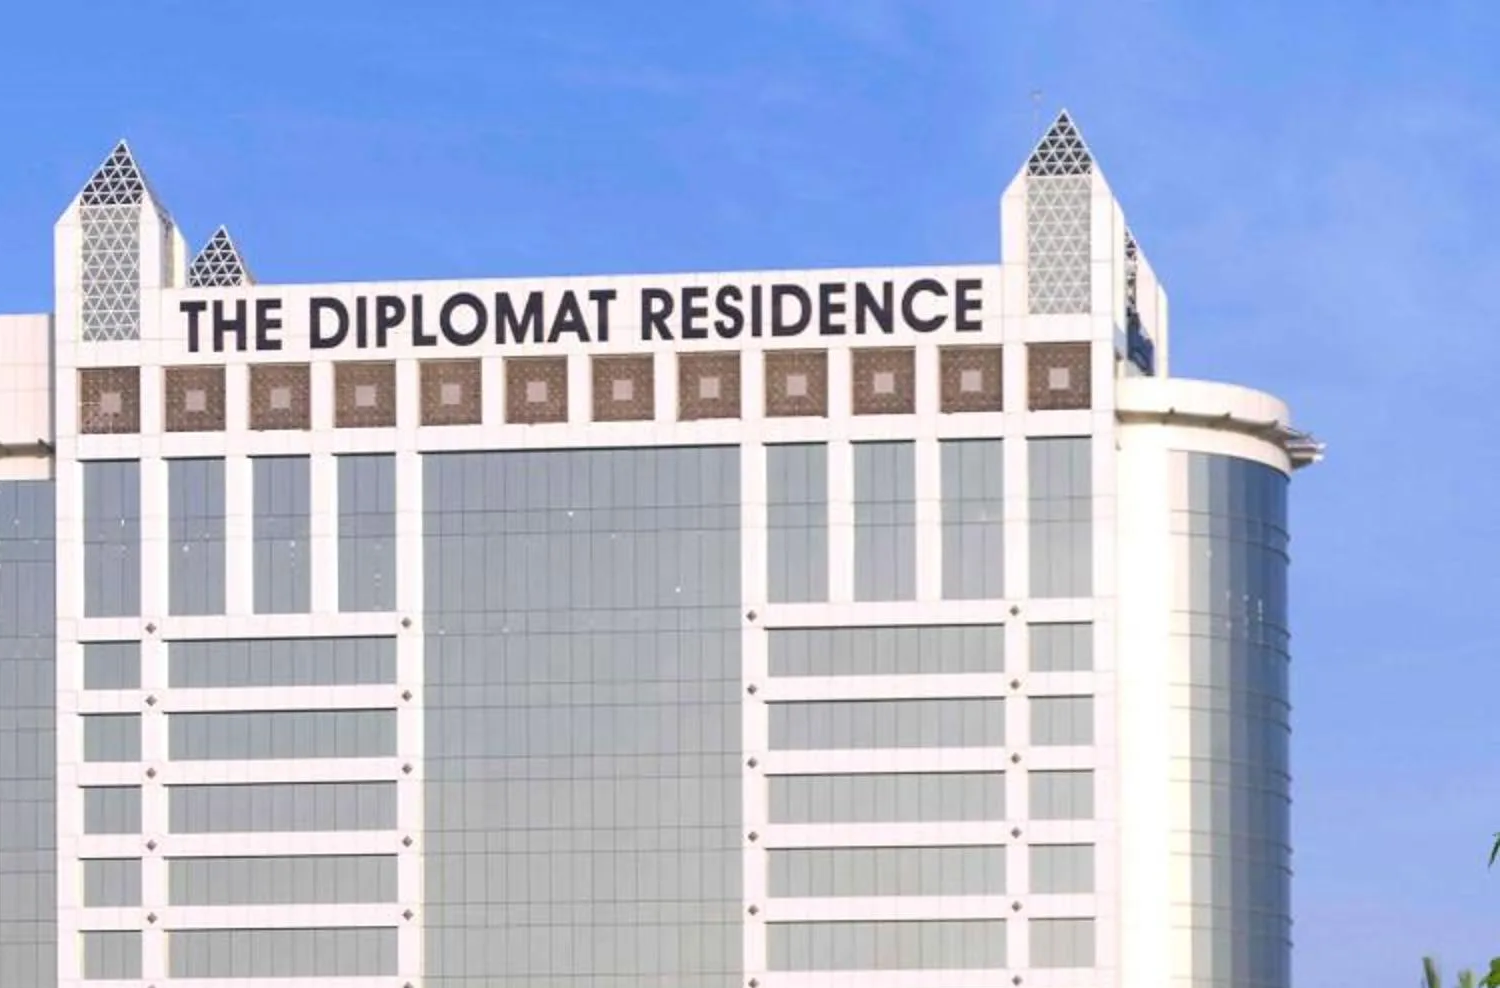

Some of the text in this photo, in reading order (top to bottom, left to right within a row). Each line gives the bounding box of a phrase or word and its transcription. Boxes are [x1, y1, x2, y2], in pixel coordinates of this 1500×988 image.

[180, 278, 984, 353] THE DIPLOMAT RESIDENCE
